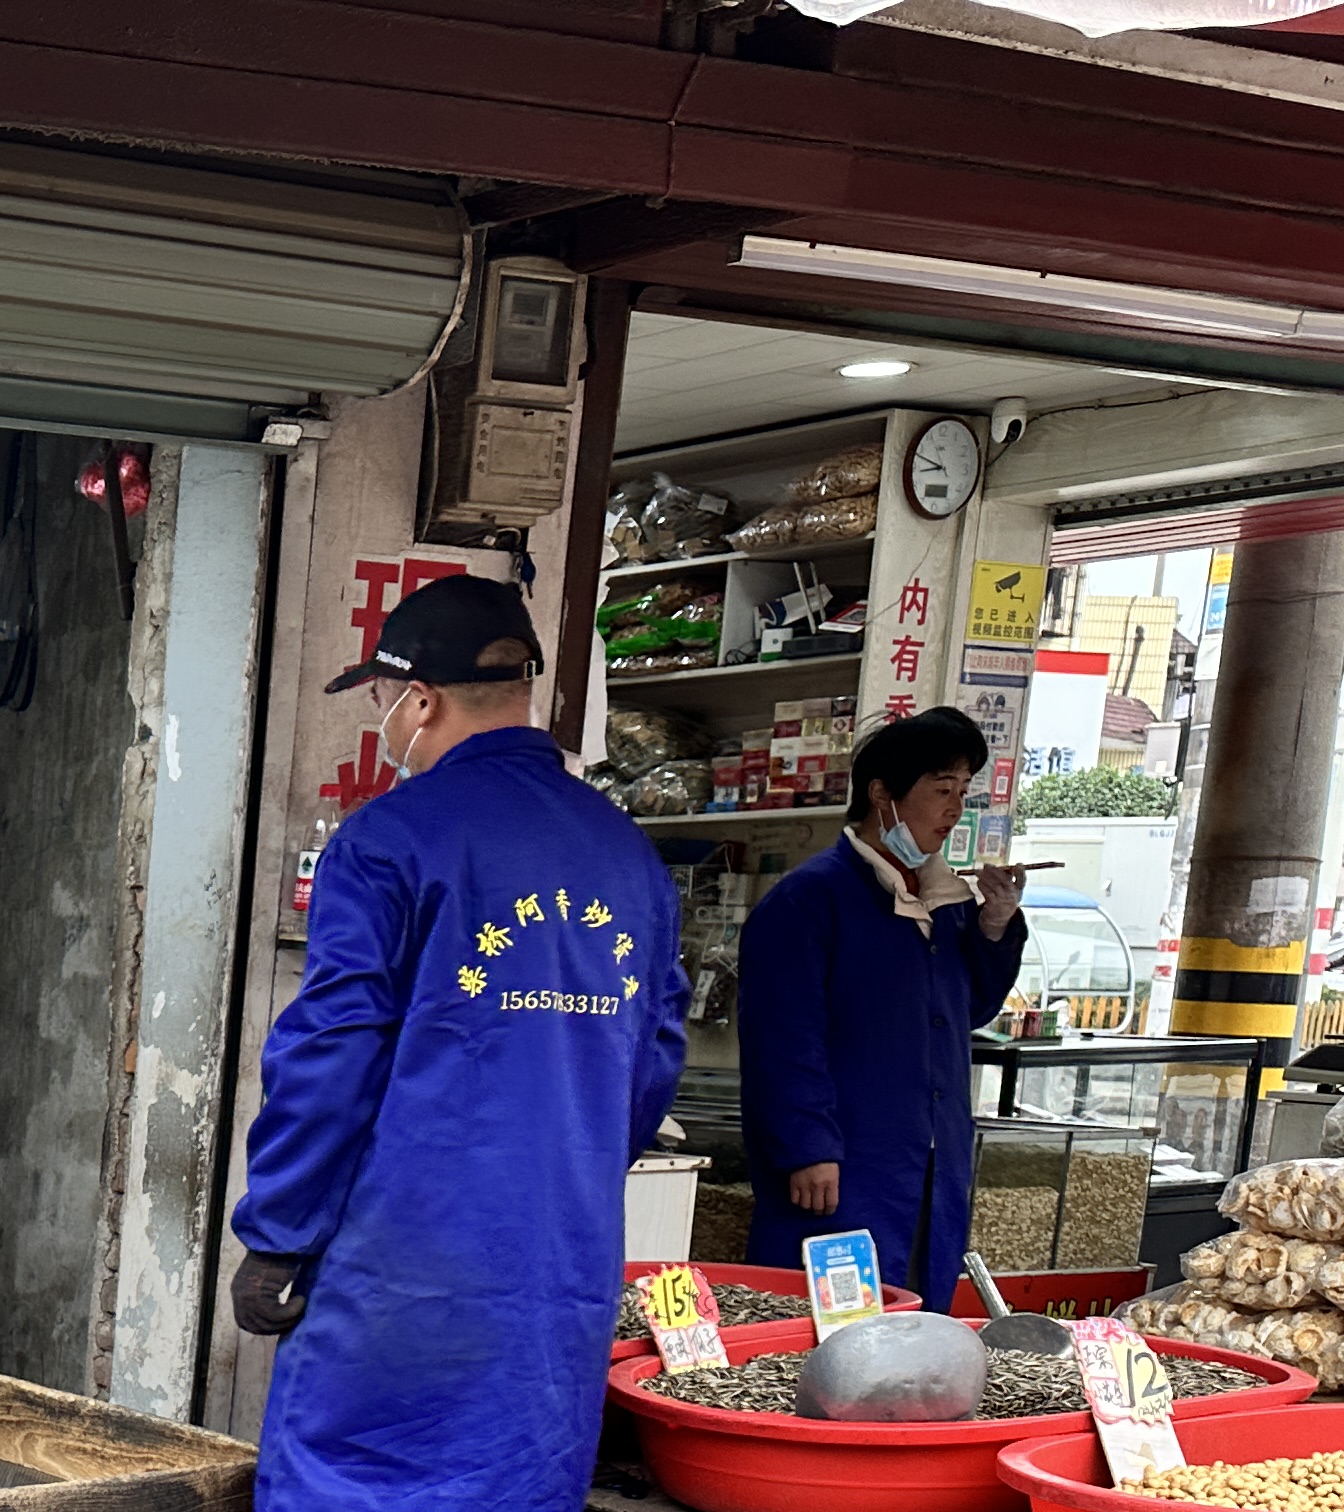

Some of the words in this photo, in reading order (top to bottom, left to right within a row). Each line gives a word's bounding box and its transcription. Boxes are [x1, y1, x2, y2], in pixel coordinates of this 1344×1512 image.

[974, 607, 1035, 624] 您已进入
[972, 622, 1034, 640] 视频监控范围
[1126, 1347, 1169, 1409] 12
